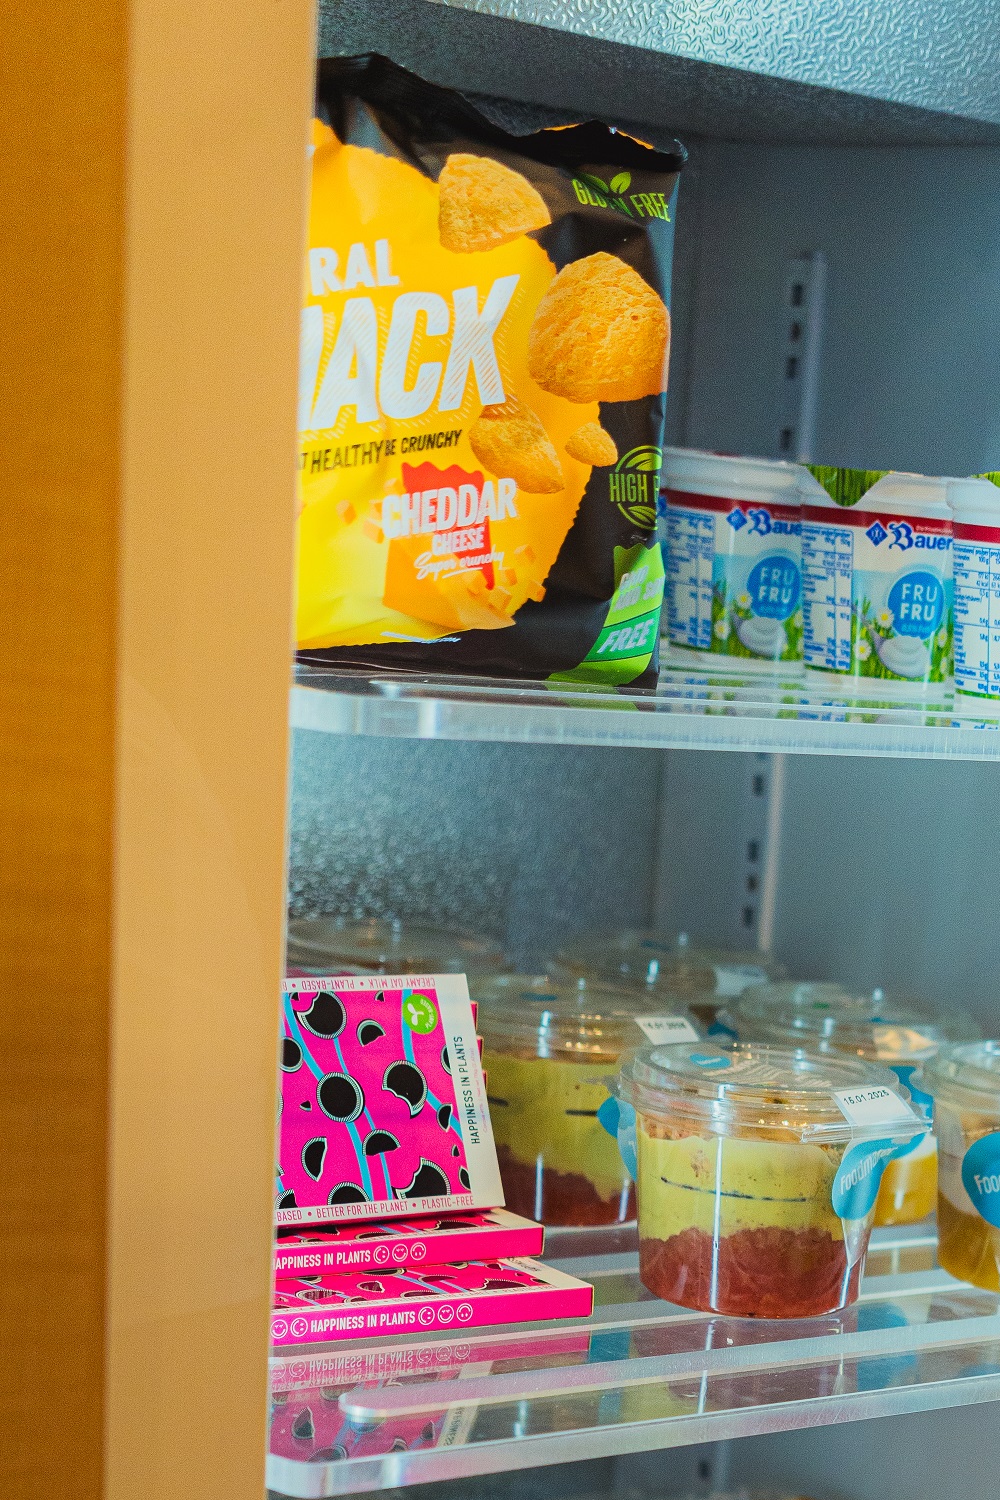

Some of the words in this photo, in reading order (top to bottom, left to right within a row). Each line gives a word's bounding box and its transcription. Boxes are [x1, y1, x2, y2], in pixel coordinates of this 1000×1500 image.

[630, 193, 671, 222] FREE
[310, 440, 382, 474] HEALTHY
[401, 429, 463, 454] CRUNCHY
[609, 473, 647, 503] HIGH
[382, 478, 518, 539] CHEDDAR
[748, 509, 801, 536] Baue
[432, 526, 484, 556] CHEESE
[889, 522, 953, 551] Bauer
[414, 551, 457, 581] Super
[459, 545, 504, 571] crunchy
[760, 567, 795, 585] FRU
[758, 586, 792, 603] FRU
[901, 583, 937, 602] FRU
[900, 604, 934, 621] FRU
[597, 619, 654, 653] FREE
[302, 979, 355, 991] PLANT-BASED
[453, 1036, 469, 1073] PLANTS
[461, 1075, 470, 1087] IN
[463, 1090, 481, 1145] HAPPINESS
[316, 1205, 345, 1218] BETTER
[347, 1204, 362, 1216] FOR
[365, 1203, 378, 1215] THE
[380, 1201, 408, 1213] PLANET
[422, 1196, 474, 1209] PLASTIC-FREE
[324, 1253, 333, 1266] IN
[336, 1250, 370, 1265] PLANTS
[310, 1316, 364, 1333] HAPPINESS
[367, 1315, 377, 1328] IN
[380, 1311, 415, 1327] PLANTS
